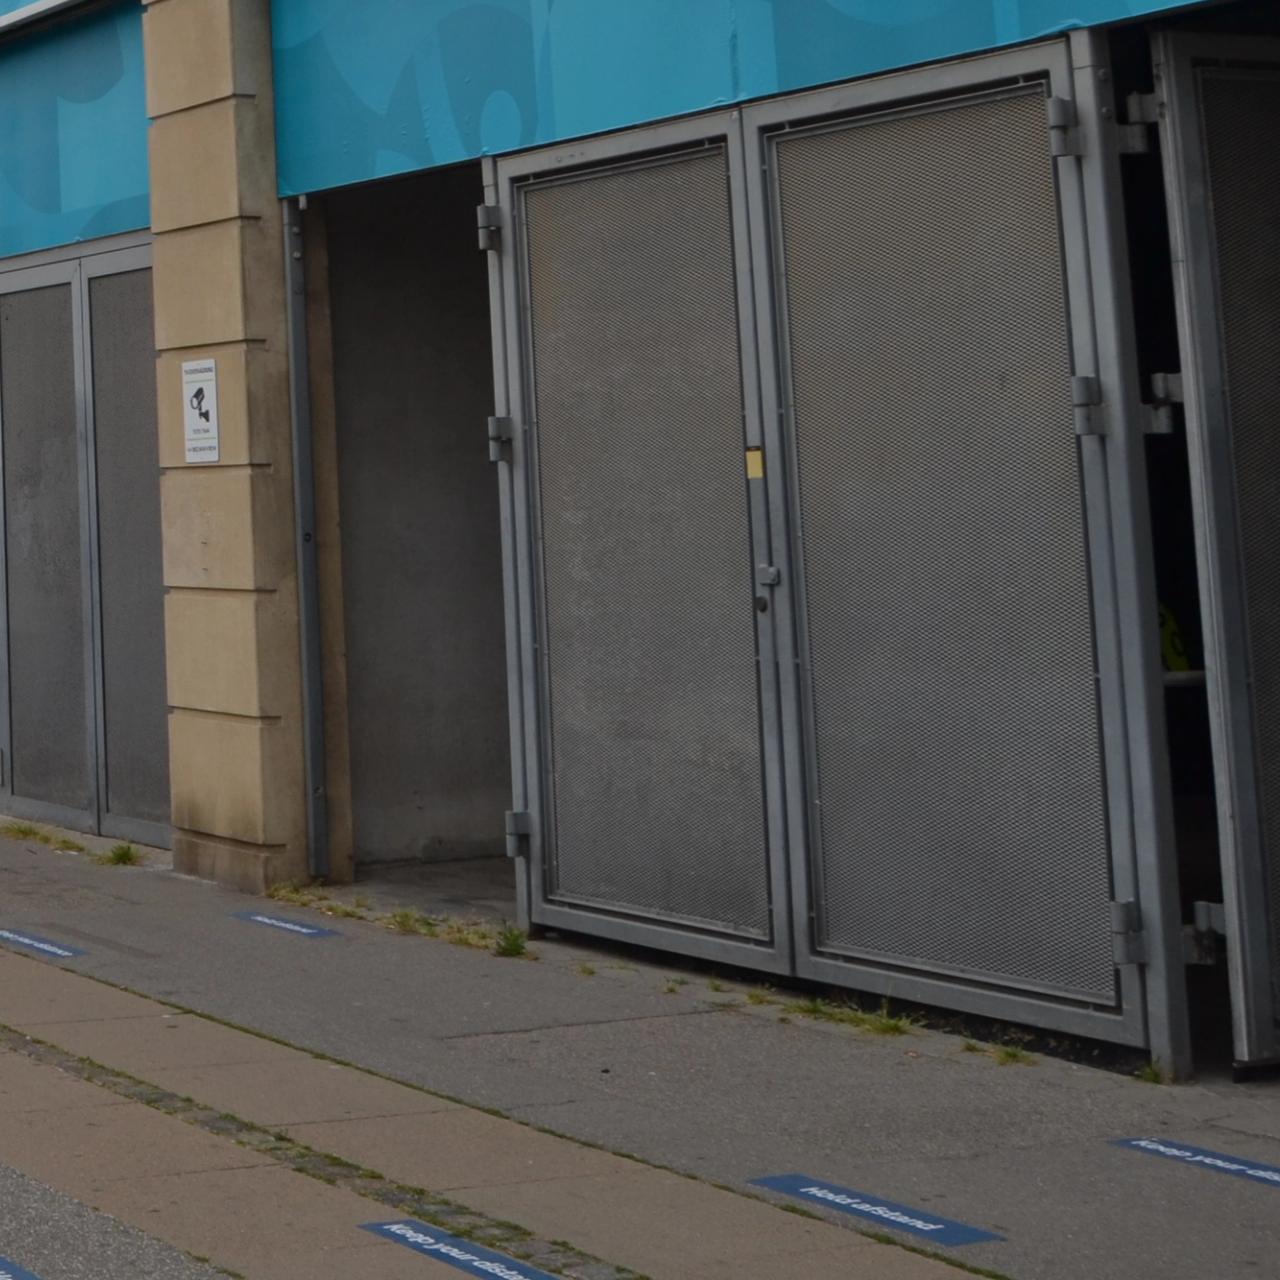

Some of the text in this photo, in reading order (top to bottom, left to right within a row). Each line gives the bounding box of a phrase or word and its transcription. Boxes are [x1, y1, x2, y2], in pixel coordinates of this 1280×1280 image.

[799, 1186, 945, 1231] Hold afstand
[383, 1223, 435, 1244] Keep
[423, 1242, 480, 1261] your
